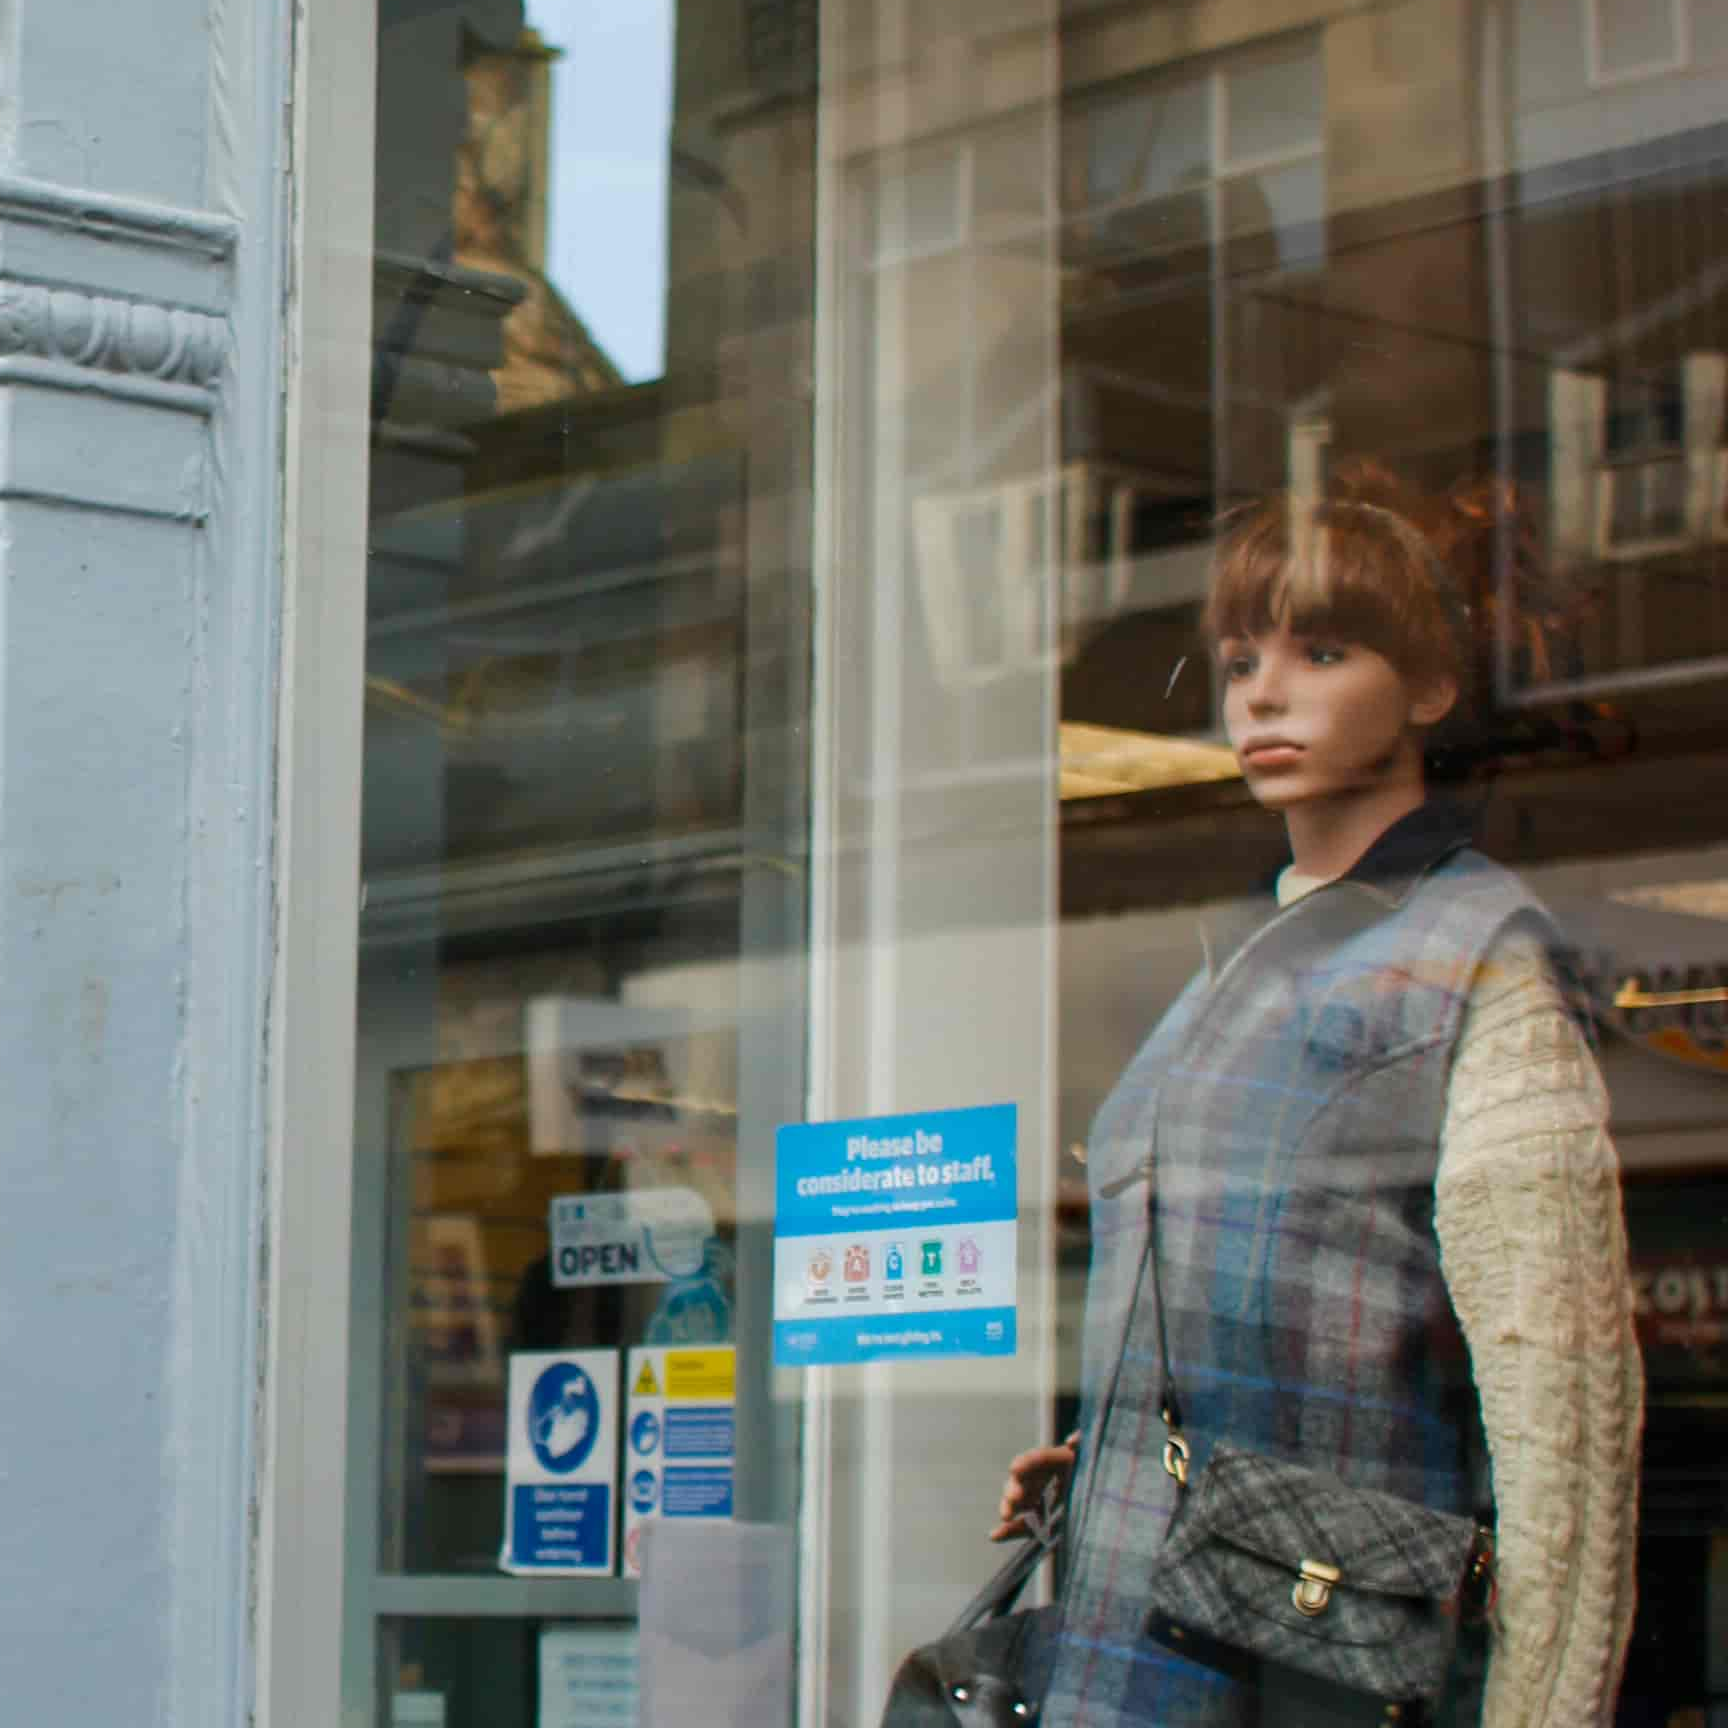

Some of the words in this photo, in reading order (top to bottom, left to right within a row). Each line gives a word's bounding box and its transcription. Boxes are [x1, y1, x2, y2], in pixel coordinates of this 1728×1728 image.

[846, 1135, 913, 1160] Please
[915, 1129, 943, 1154] be
[796, 1163, 914, 1197] considerate
[917, 1163, 939, 1185] to
[559, 1242, 640, 1277] OPEN
